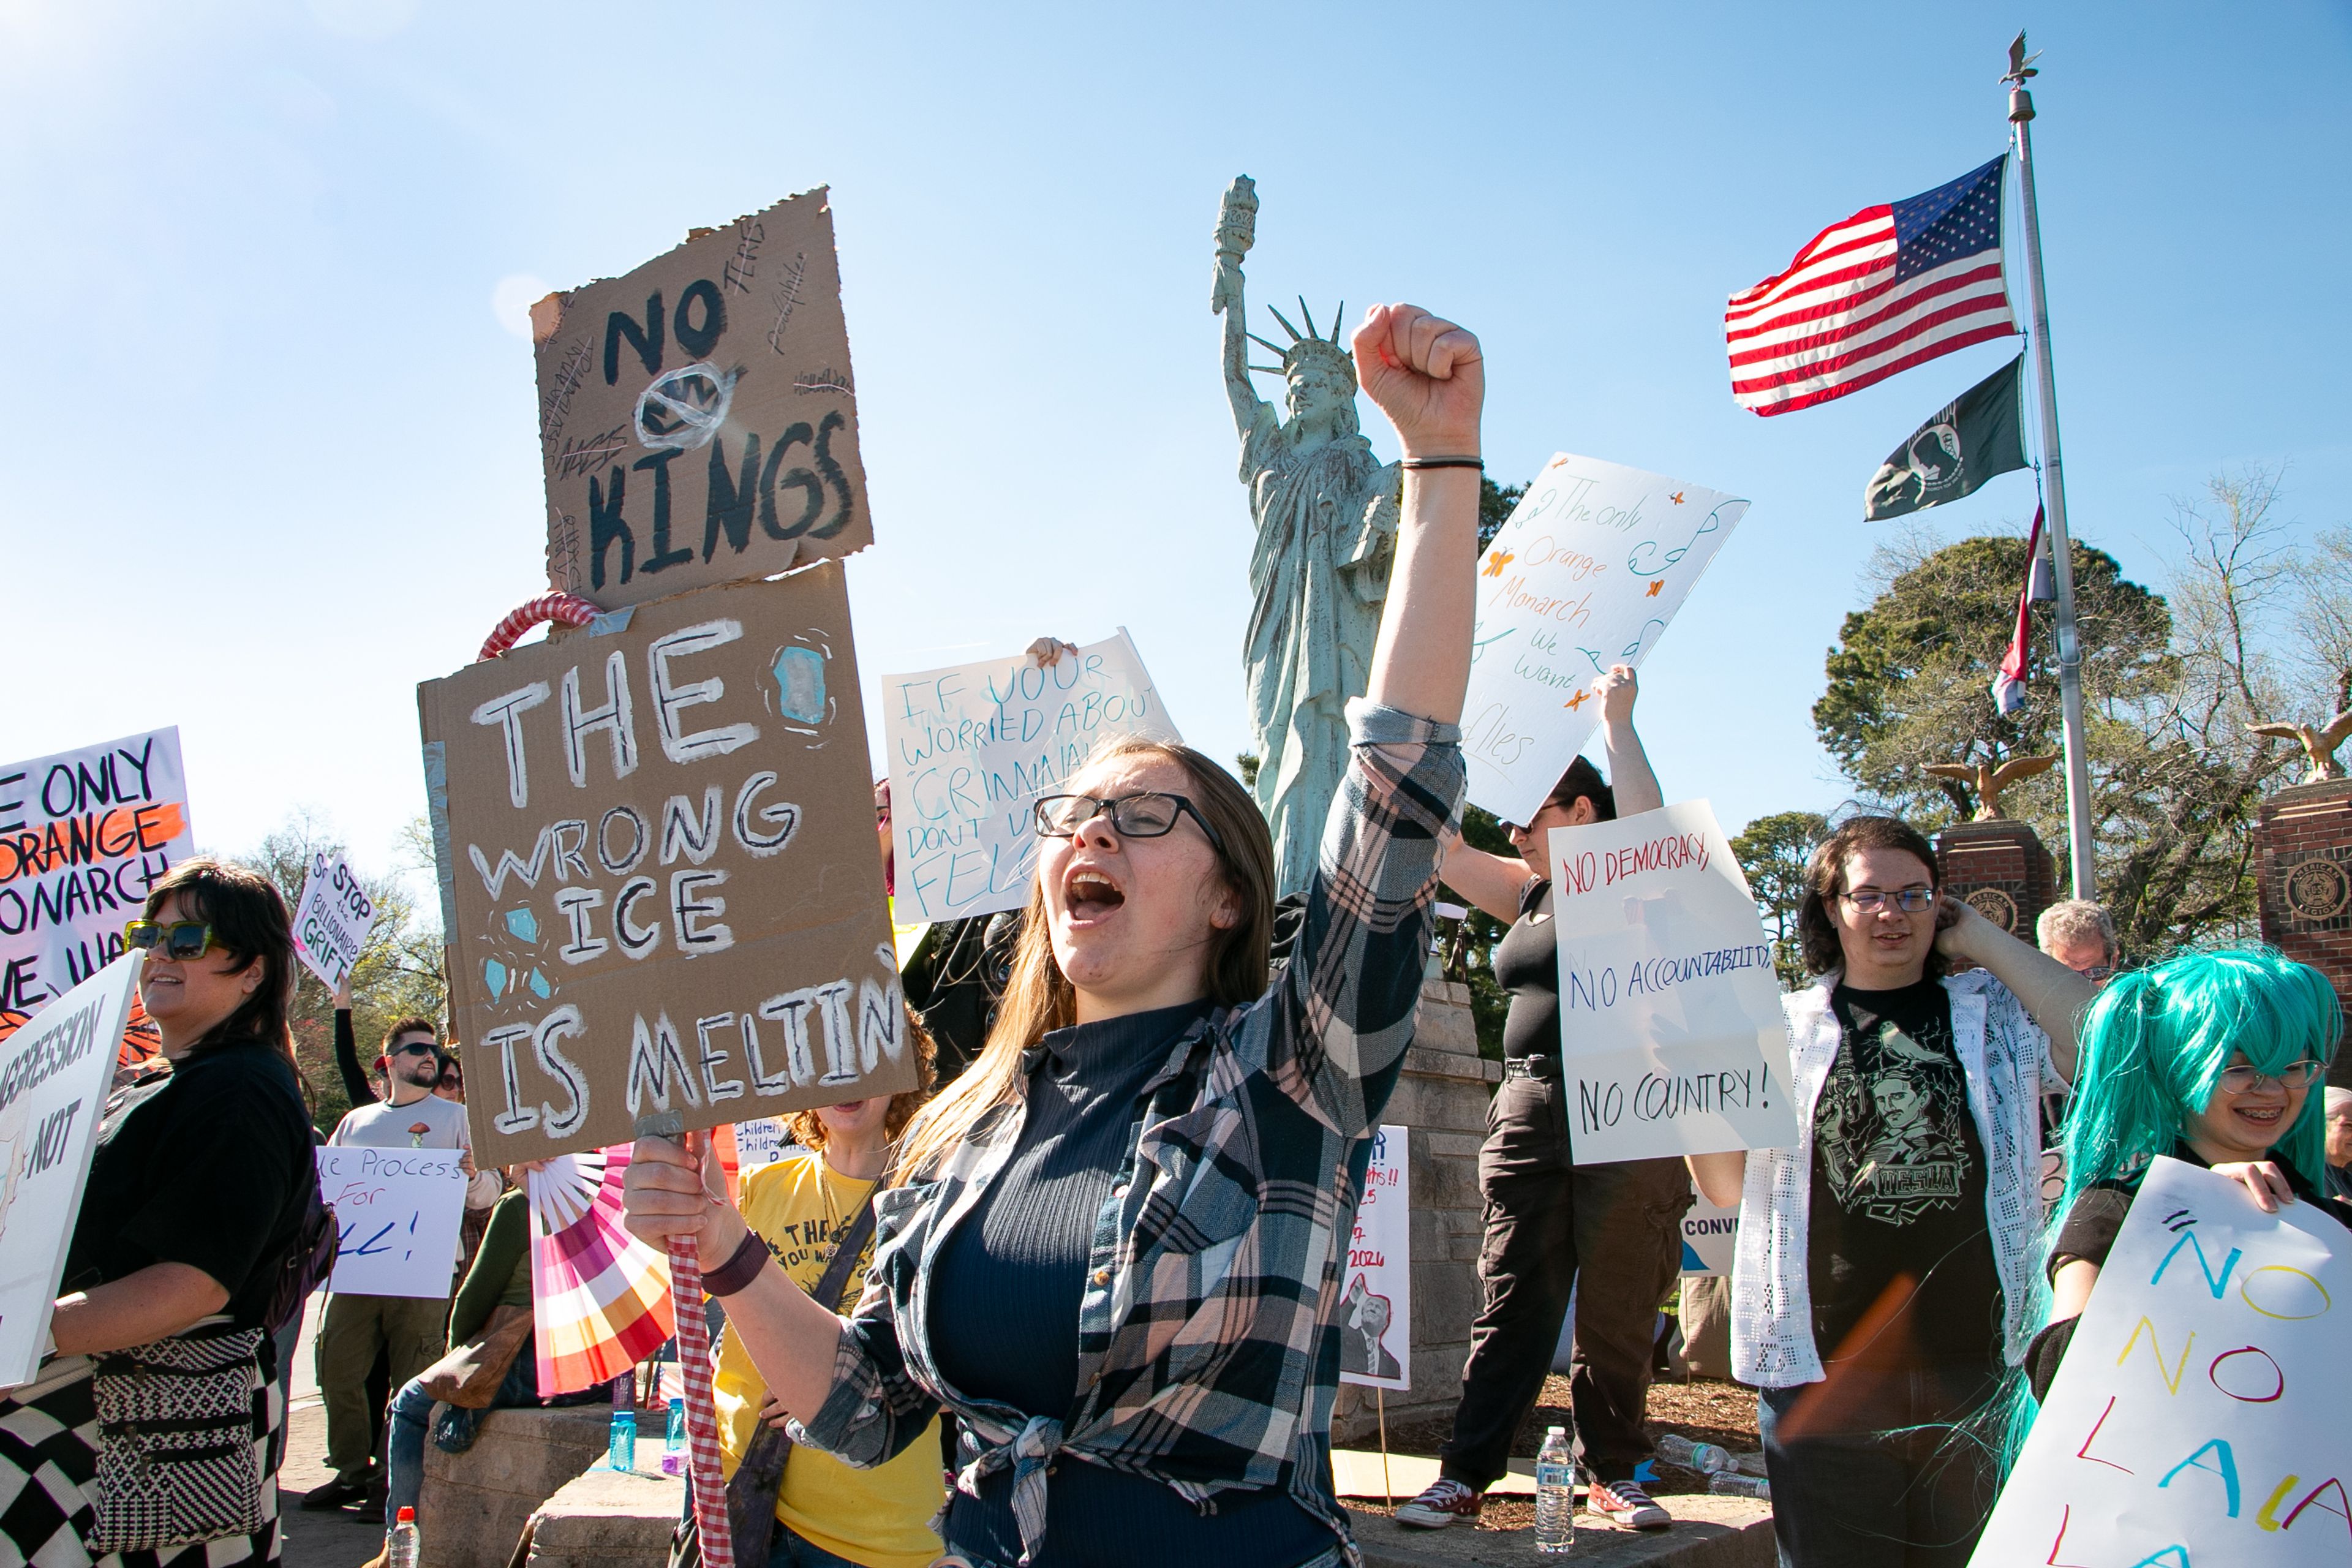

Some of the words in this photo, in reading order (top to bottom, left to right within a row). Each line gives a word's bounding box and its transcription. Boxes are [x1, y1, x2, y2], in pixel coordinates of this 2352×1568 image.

[603, 279, 728, 386] NO
[589, 409, 853, 593] KINGS
[1555, 475, 1600, 522] The
[1596, 494, 1649, 532] only
[1524, 535, 1608, 582] Orange
[1488, 576, 1593, 629] Monarch
[1531, 627, 1557, 657] We
[470, 619, 761, 809] THE
[895, 673, 966, 720] IF
[900, 703, 1044, 767] WORRIED
[1055, 685, 1157, 735] ABOUT
[41, 737, 153, 818] ONLY
[468, 771, 802, 902] WRONG
[333, 863, 371, 921] STOP
[1562, 851, 1596, 896] NO
[1971, 893, 2010, 908] MERICAN
[2293, 864, 2340, 883] AMERICAN
[336, 899, 349, 923] the
[554, 870, 736, 965] ICE
[2298, 902, 2337, 915] LEGION
[304, 918, 349, 984] GRIFT
[1570, 967, 1617, 1011] NO
[481, 1004, 590, 1139] IS
[1580, 1077, 1623, 1135] NO
[1634, 1061, 1770, 1121] COUNTRY!
[26, 1097, 82, 1180] NOT
[362, 1148, 461, 1180] Process
[336, 1182, 386, 1205] For
[1880, 1166, 1954, 1194] TESLA
[777, 1248, 809, 1271] YOU
[2117, 1314, 2283, 1403] NO
